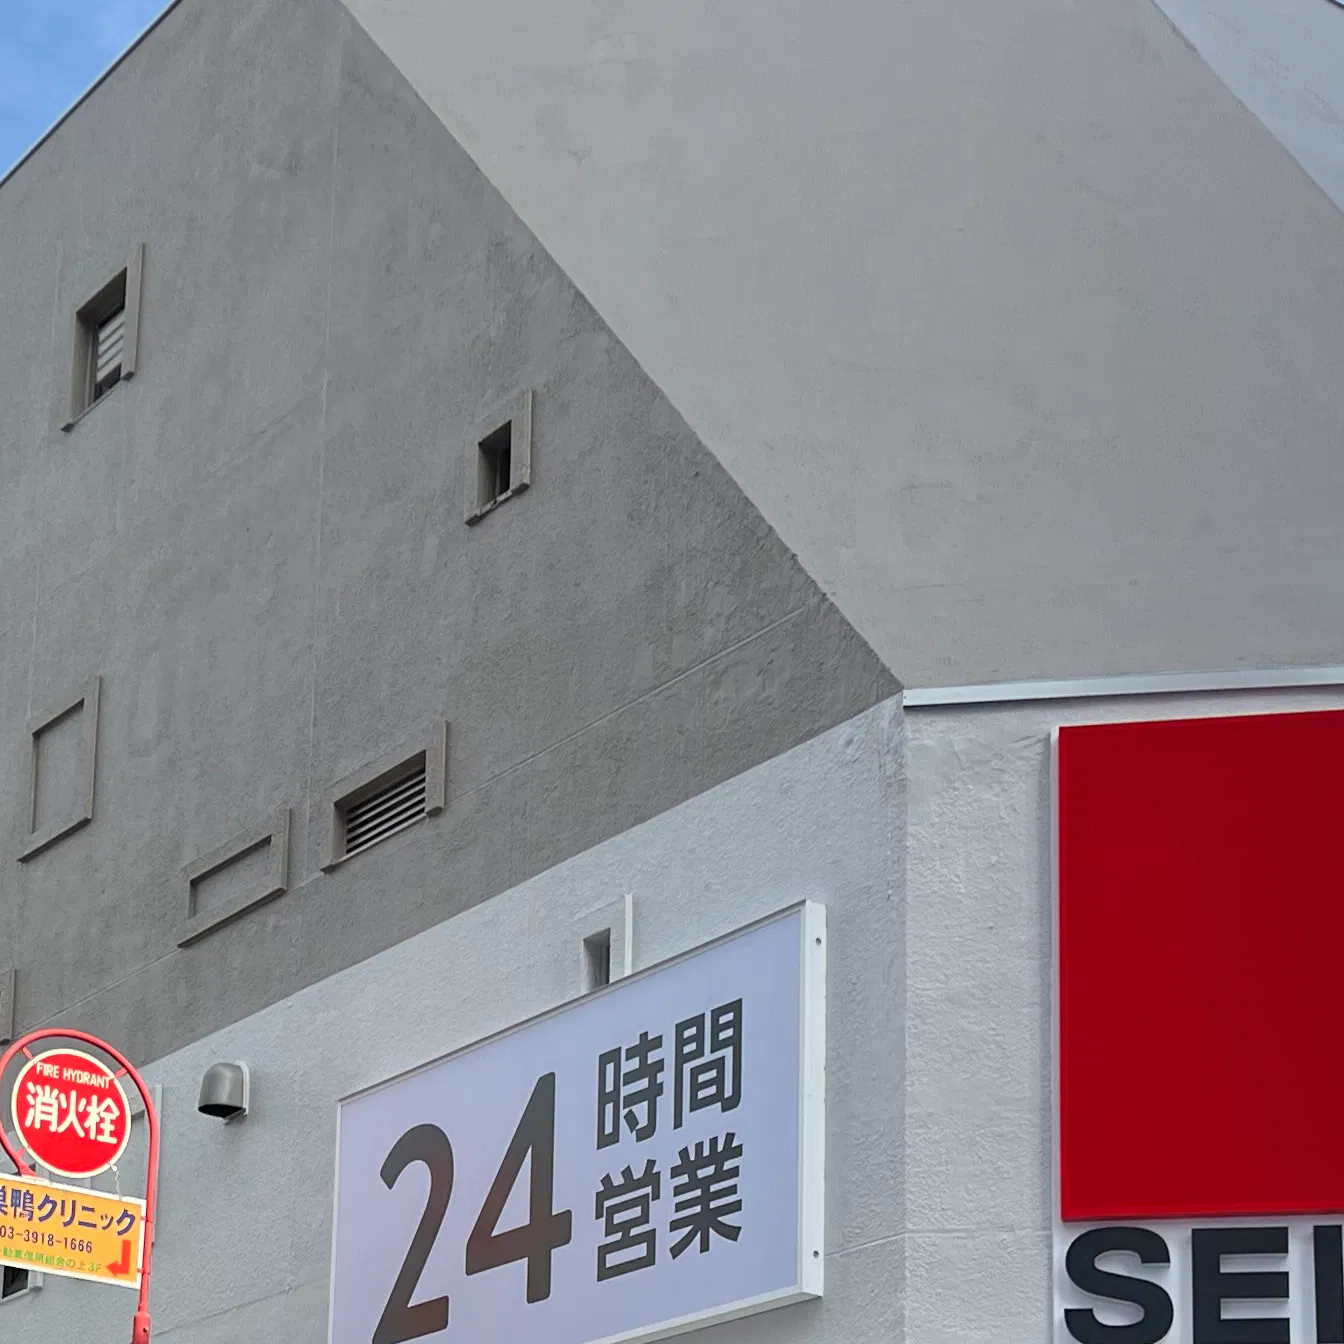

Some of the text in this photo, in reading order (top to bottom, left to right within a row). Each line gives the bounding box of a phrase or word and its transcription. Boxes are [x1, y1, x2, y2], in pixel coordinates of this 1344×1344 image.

[35, 1061, 112, 1090] FIRE HYDRANT
[595, 997, 743, 1151] 時間
[24, 1081, 120, 1144] 消火栓
[594, 1131, 744, 1283] 営業
[0, 1225, 93, 1254] 03-3918-1666
